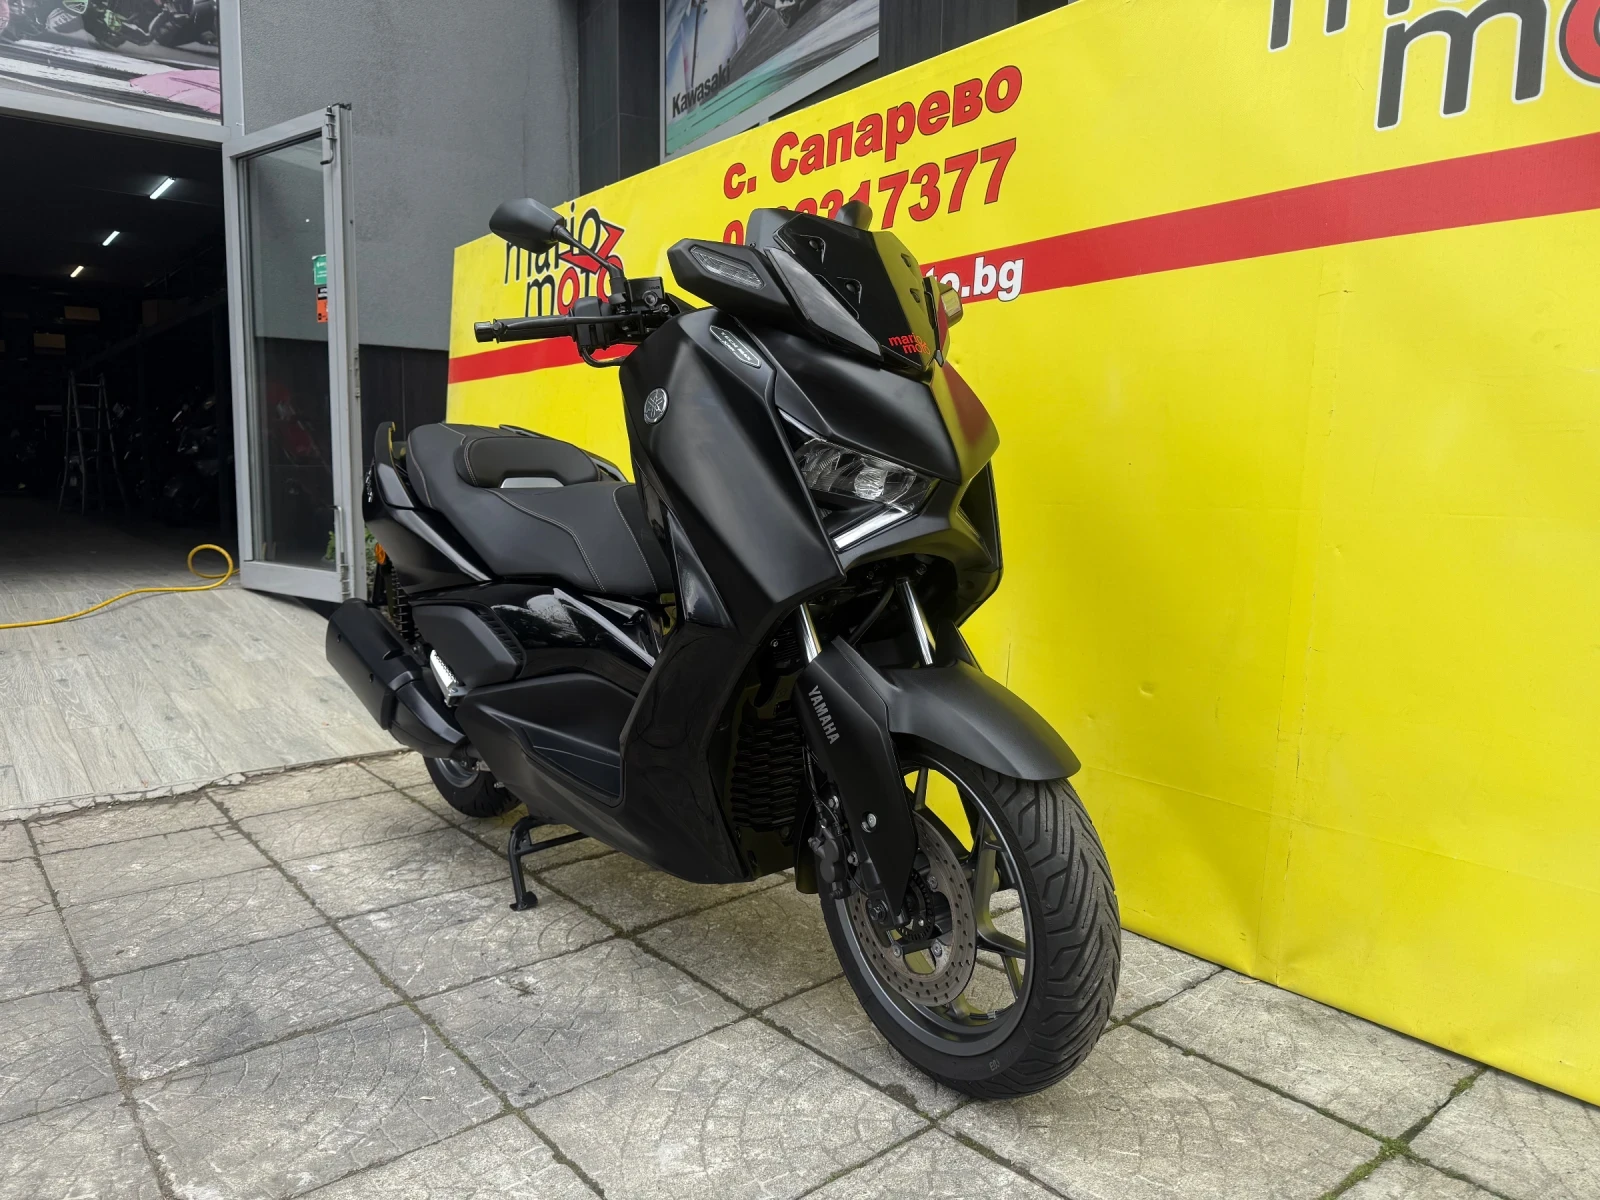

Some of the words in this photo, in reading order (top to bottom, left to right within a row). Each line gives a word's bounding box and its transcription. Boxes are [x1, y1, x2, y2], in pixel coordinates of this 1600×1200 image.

[672, 58, 731, 118] Kawasaki
[723, 162, 757, 199] с.
[770, 64, 1023, 184] Сапарево
[888, 332, 922, 347] mario
[902, 341, 931, 356] moto
[808, 685, 840, 745] YAMAHA
